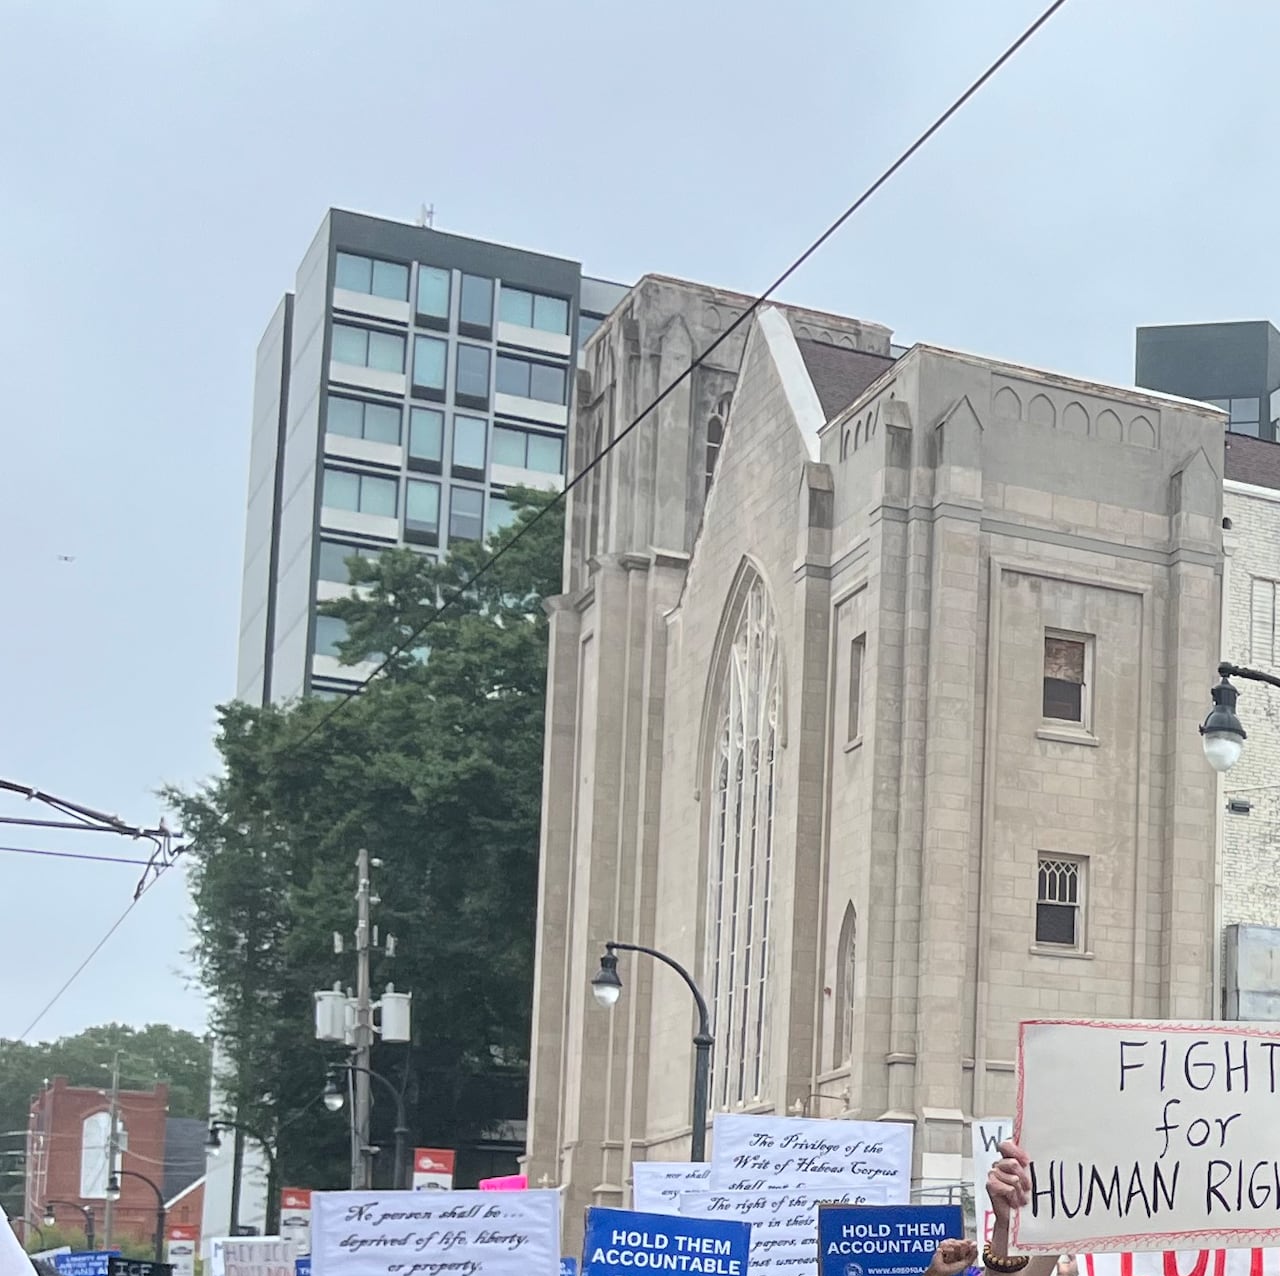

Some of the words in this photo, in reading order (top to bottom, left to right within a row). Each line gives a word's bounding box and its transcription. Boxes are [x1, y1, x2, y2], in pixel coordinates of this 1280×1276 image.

[1155, 1098, 1242, 1158] for
[749, 1132, 774, 1148] The
[780, 1132, 840, 1156] Privilege
[844, 1141, 864, 1157] of
[864, 1142, 884, 1154] the
[733, 1154, 770, 1169] Writ
[774, 1159, 794, 1175] of
[795, 1155, 845, 1174] Habeas
[850, 1161, 899, 1180] Corpus
[728, 1179, 767, 1191] shall
[1029, 1160, 1181, 1220] HUMAN
[345, 1202, 378, 1222] No
[373, 1210, 431, 1226] person
[439, 1205, 482, 1219] shall
[707, 1196, 731, 1211] The
[735, 1197, 766, 1214] right
[771, 1195, 789, 1213] of
[788, 1195, 806, 1208] the
[768, 1218, 781, 1227] in
[786, 1214, 815, 1227] their
[842, 1224, 891, 1238] HOLD
[896, 1222, 946, 1236] THEM
[339, 1232, 416, 1252] deprived
[416, 1232, 433, 1251] of
[612, 1230, 669, 1249] HOLD
[674, 1236, 731, 1255] THEM
[387, 1264, 404, 1273] or
[592, 1249, 741, 1276] ACCOUNTABLE
